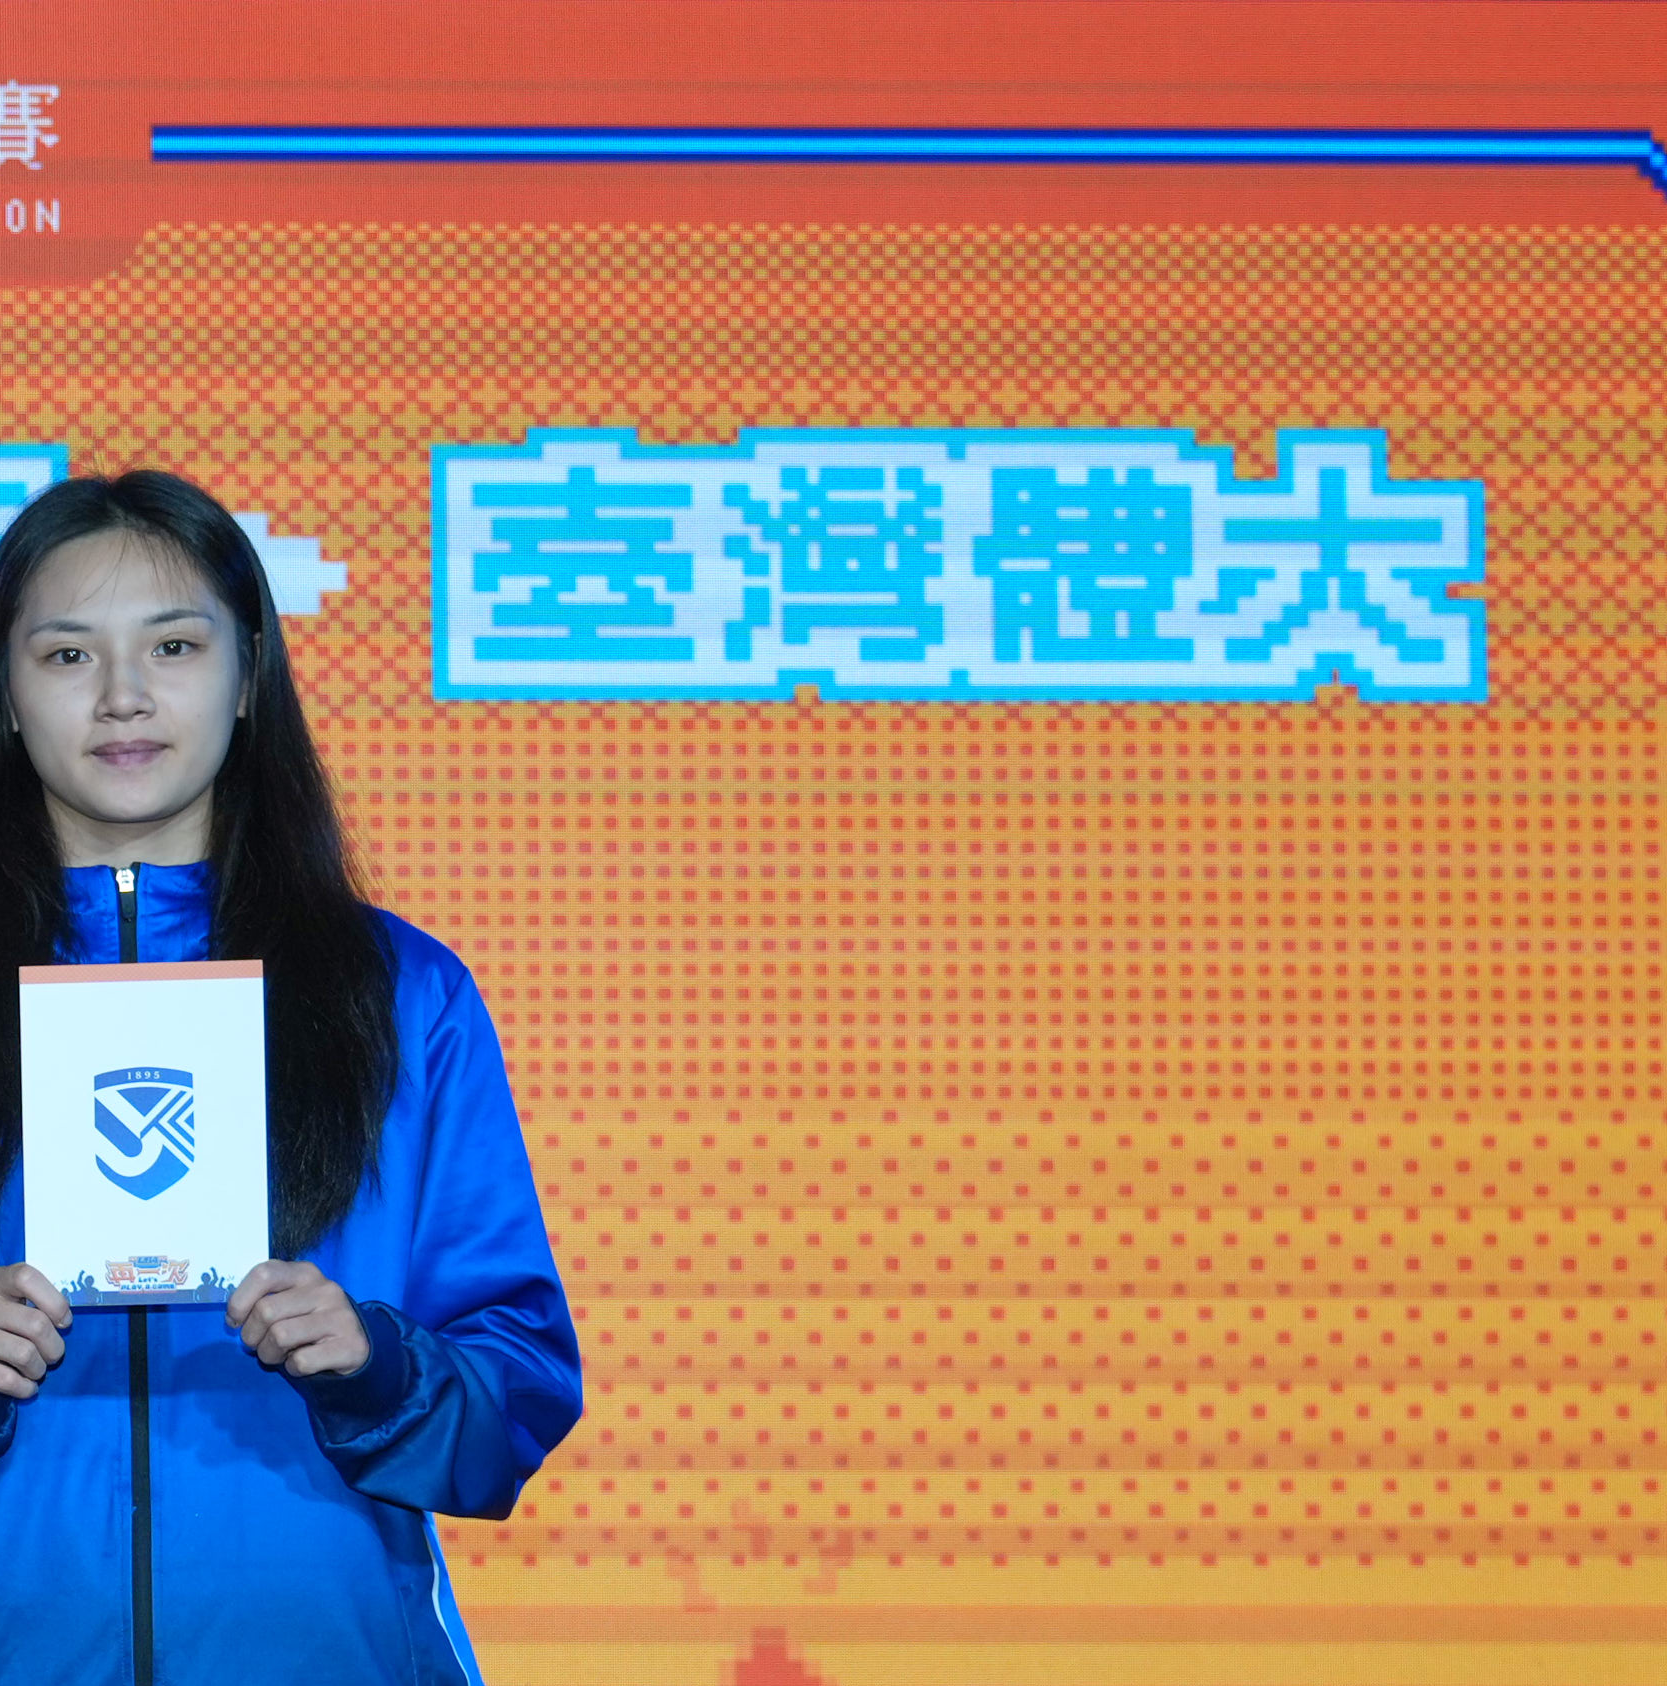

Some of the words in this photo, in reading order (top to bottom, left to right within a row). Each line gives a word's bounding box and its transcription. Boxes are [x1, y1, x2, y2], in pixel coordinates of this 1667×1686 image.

[471, 465, 1446, 664] 臺灣體大
[127, 1070, 161, 1081] 1895
